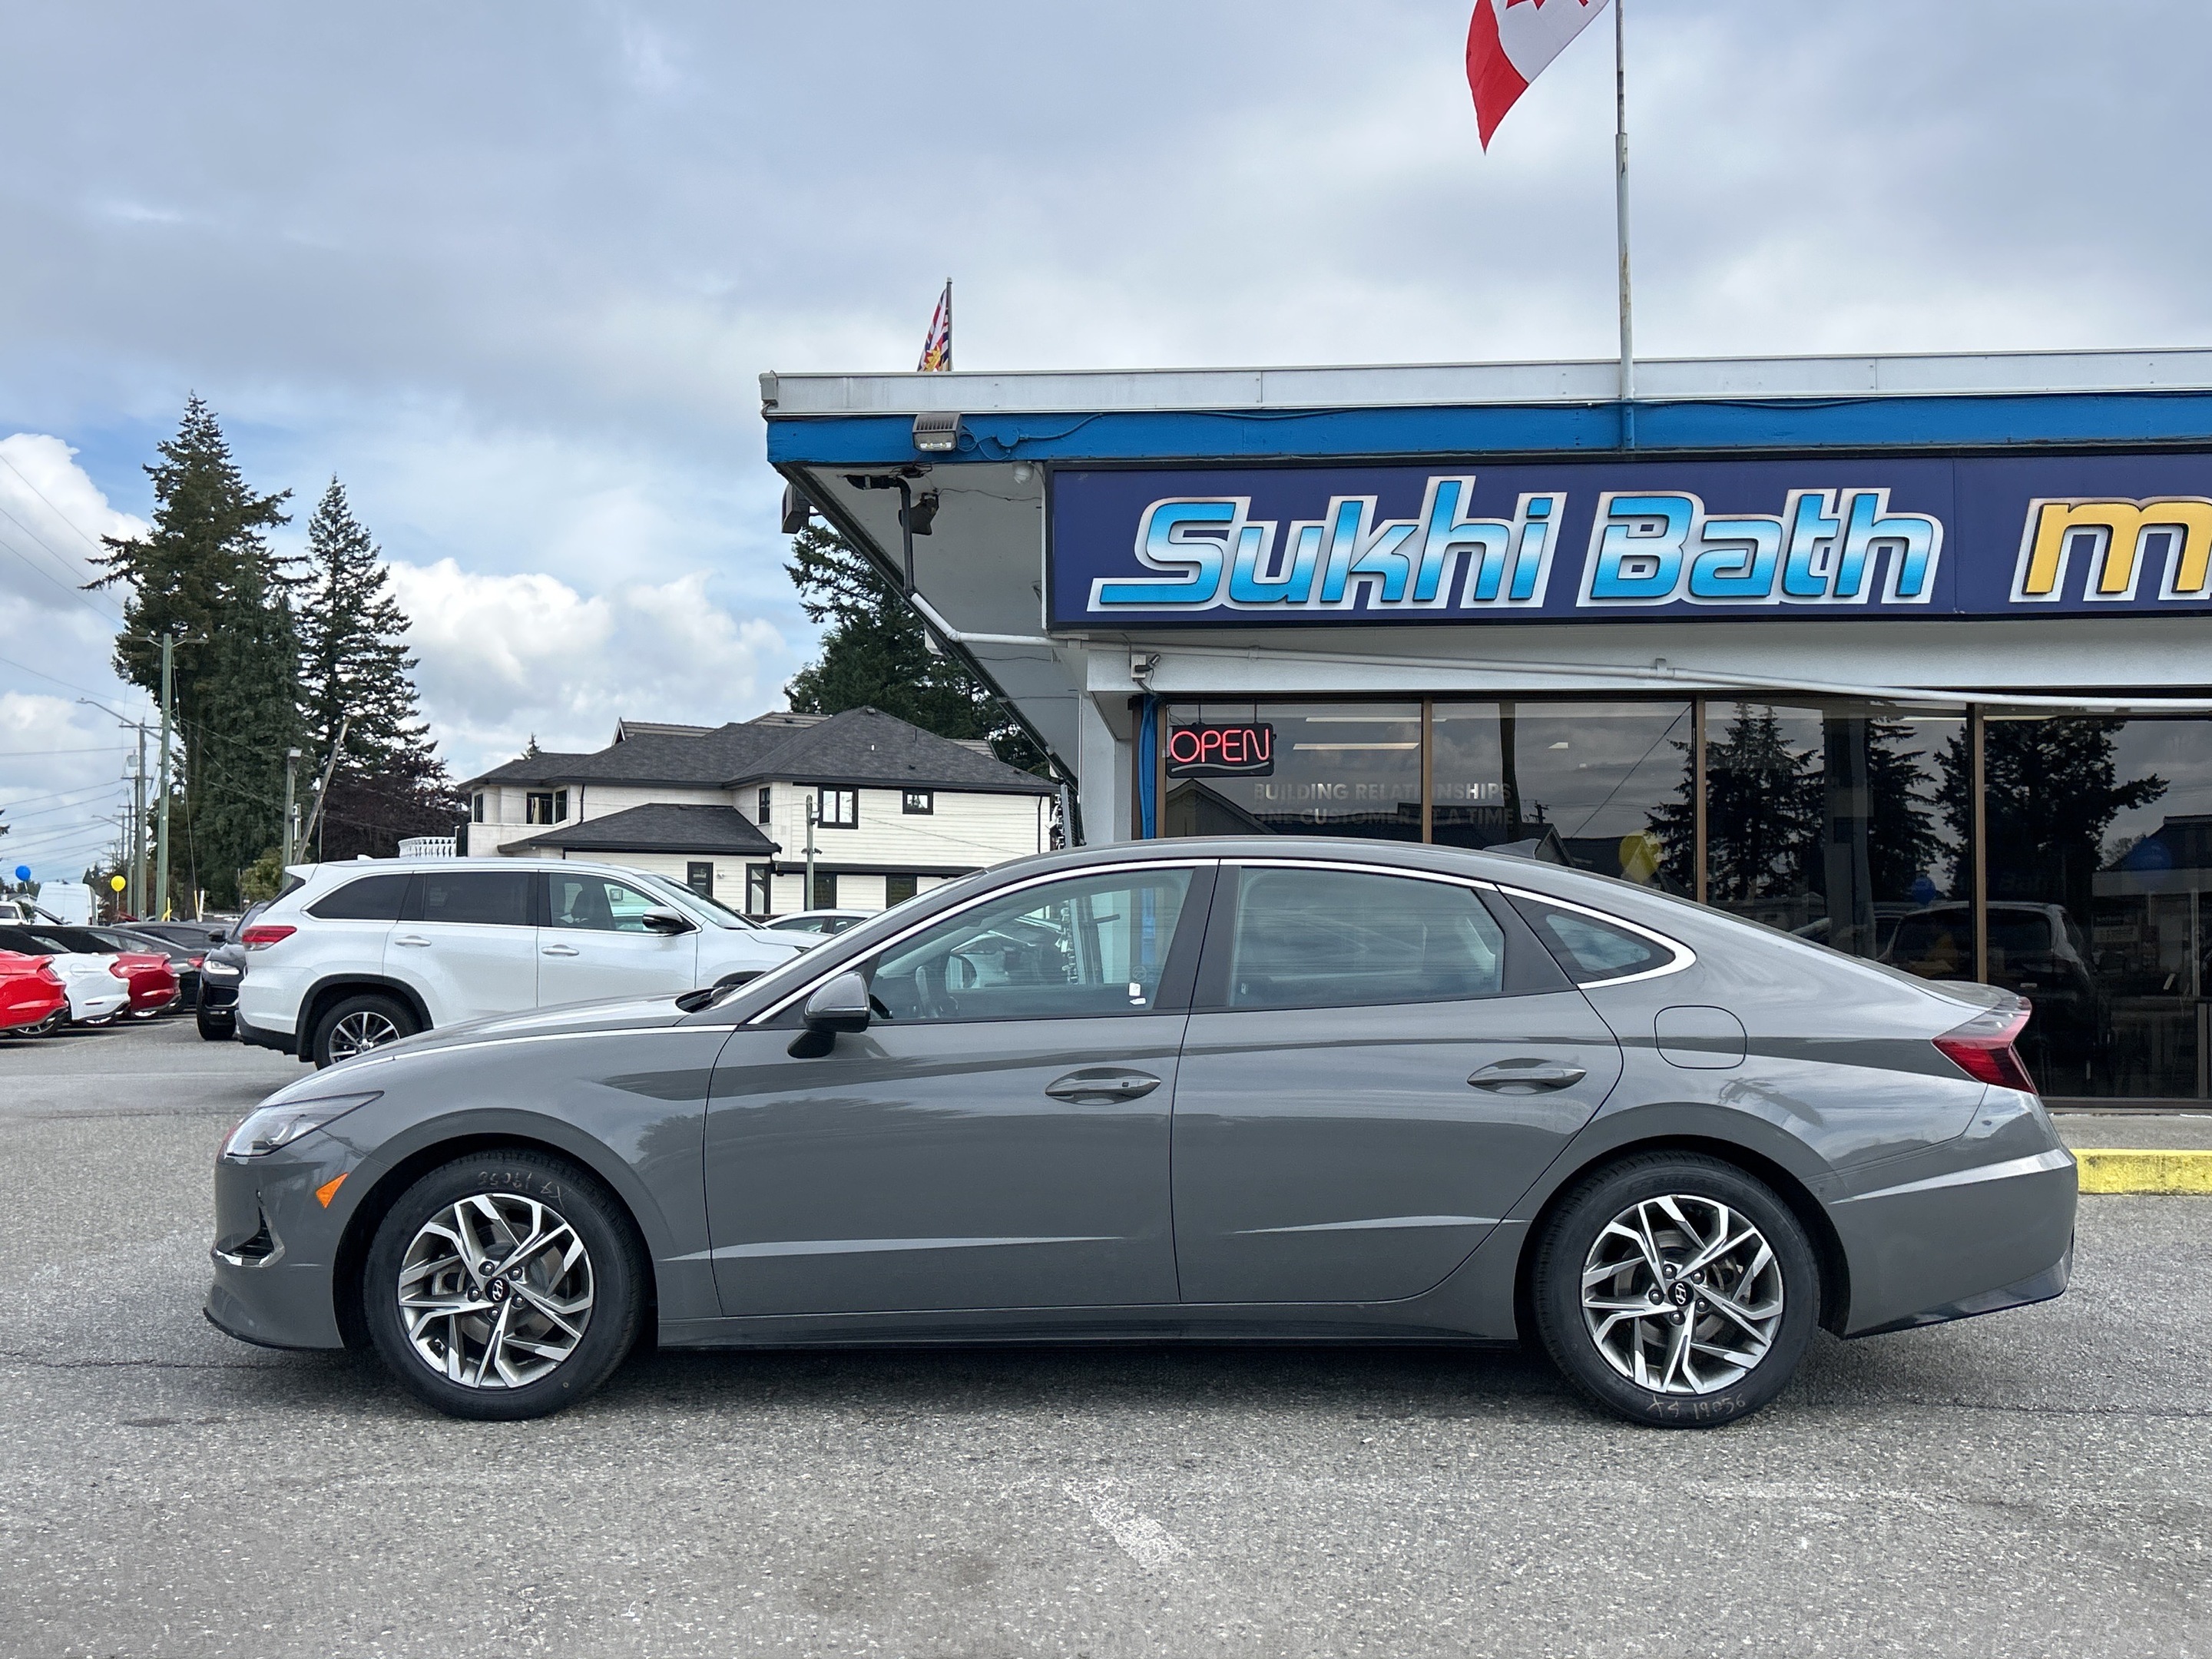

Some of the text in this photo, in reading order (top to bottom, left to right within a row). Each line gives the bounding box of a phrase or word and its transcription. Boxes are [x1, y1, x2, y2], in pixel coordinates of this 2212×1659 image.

[1088, 476, 1567, 611] Sukhi
[1576, 488, 1942, 607] Bath
[1170, 728, 1270, 763] OPEN
[1253, 783, 1349, 800] BUILDING
[1466, 808, 1513, 825] TIME
